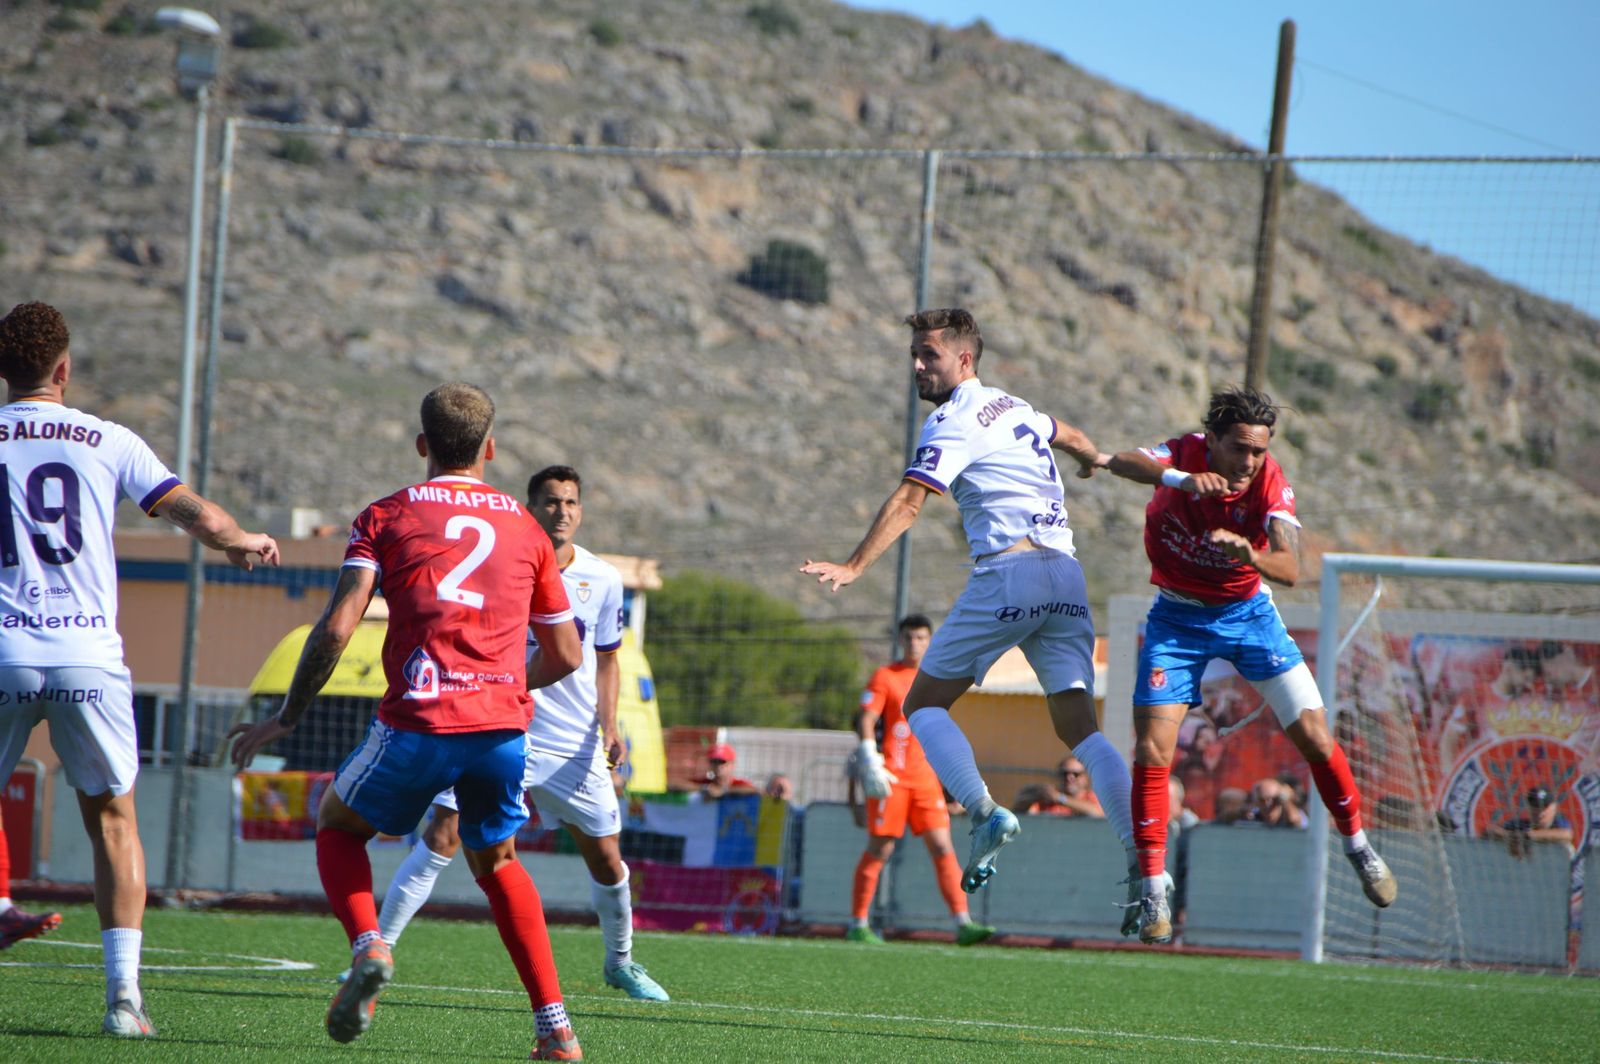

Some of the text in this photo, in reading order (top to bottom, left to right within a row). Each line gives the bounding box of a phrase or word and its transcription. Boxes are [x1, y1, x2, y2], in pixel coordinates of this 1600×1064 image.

[13, 420, 102, 448] ALONSO
[407, 486, 522, 516] MIRAPEIX
[0, 462, 83, 568] 19
[436, 514, 496, 610] 2
[44, 586, 71, 595] clibo
[0, 611, 106, 629] alderón
[1030, 602, 1089, 619] HYUNDAI
[16, 687, 103, 704] HYUNDAI
